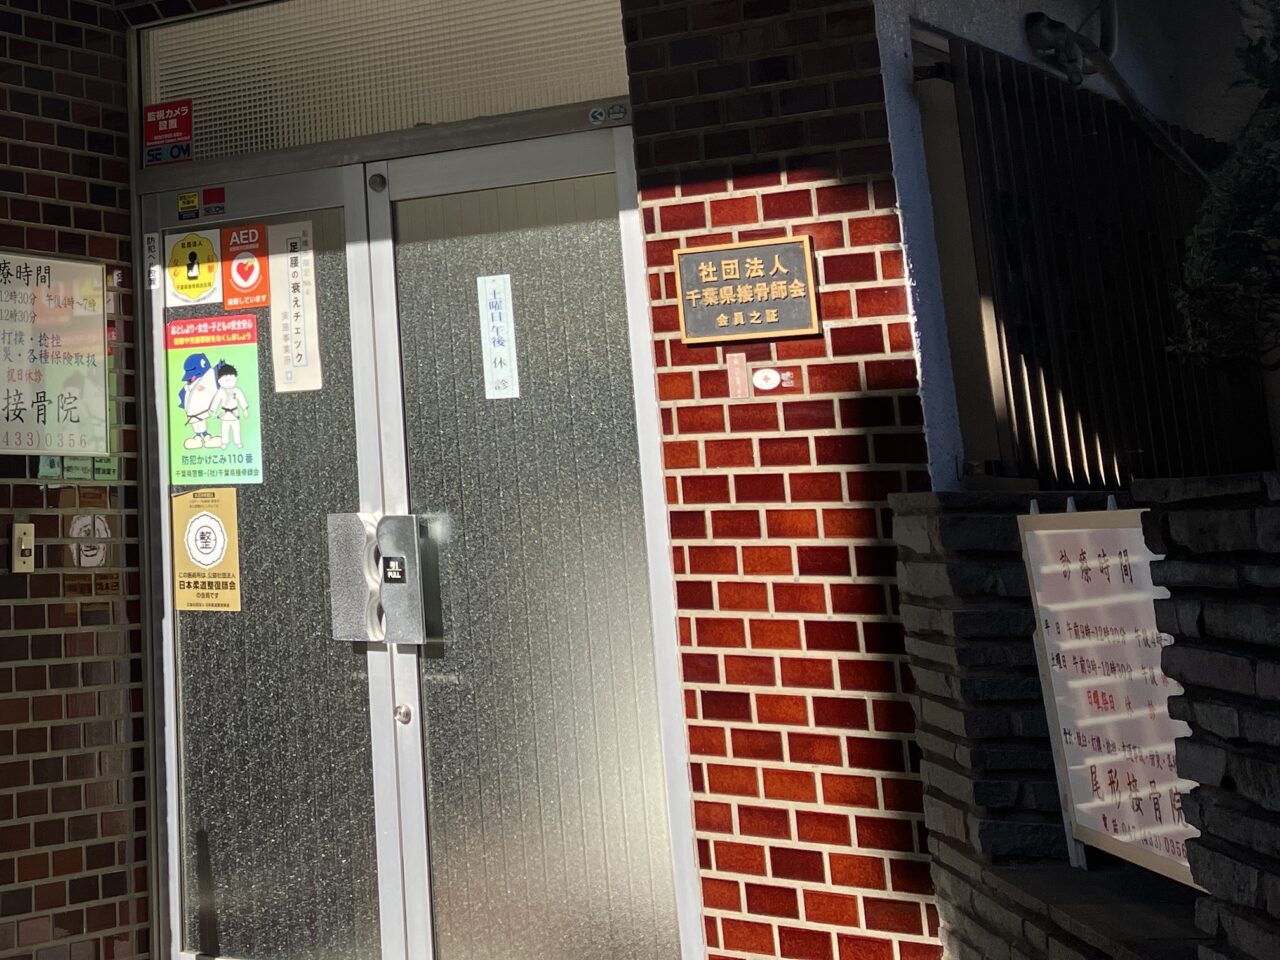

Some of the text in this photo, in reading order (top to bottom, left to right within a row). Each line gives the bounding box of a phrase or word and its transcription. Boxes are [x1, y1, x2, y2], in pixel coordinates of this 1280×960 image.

[229, 228, 259, 246] AED
[698, 254, 789, 283] 社団法人
[685, 279, 807, 309] 千葉県接骨師会
[716, 309, 780, 328] 会員之証
[1060, 548, 1133, 584] 診療時間
[1090, 764, 1189, 829] 尾形接骨院
